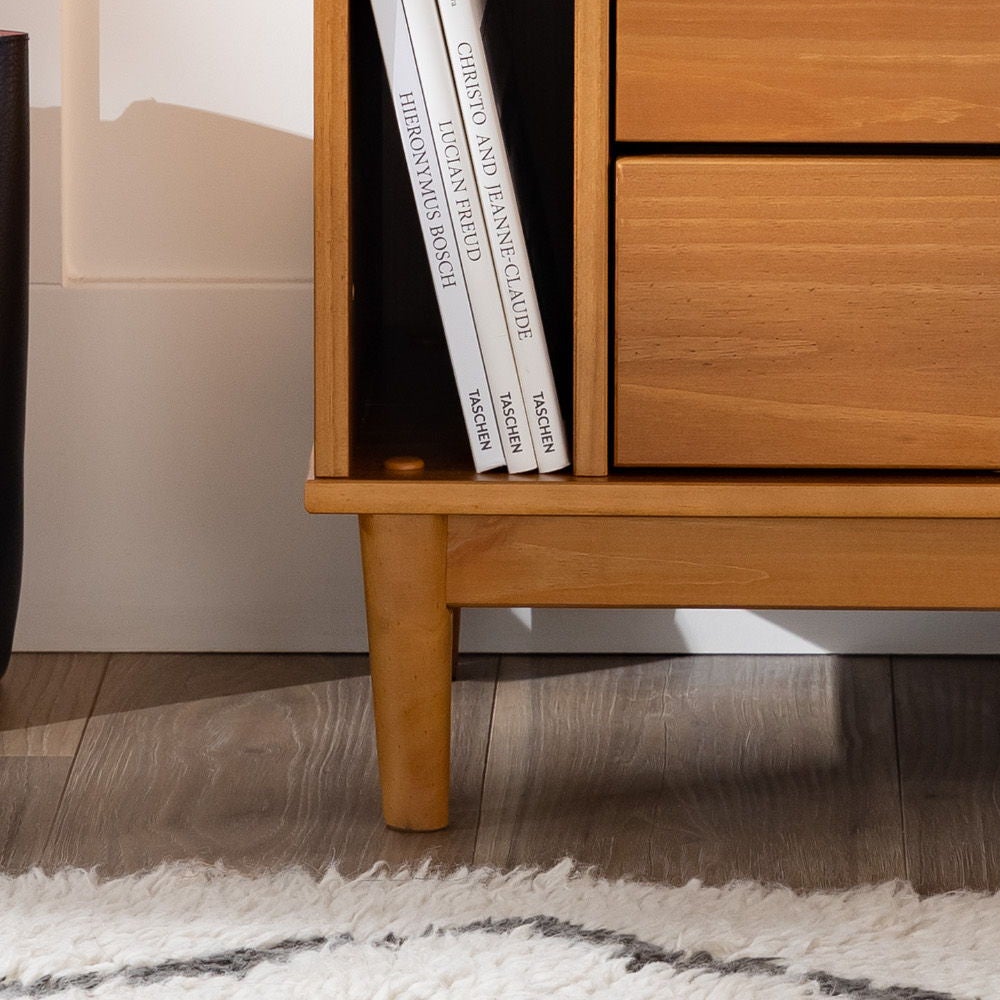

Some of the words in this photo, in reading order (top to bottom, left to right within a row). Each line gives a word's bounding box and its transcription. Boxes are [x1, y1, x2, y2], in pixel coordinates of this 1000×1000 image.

[457, 41, 487, 126] CHRISTO
[399, 91, 441, 221] HIERONYMUS
[429, 224, 456, 289] BOSCH
[438, 120, 467, 193] LUCIAN
[455, 198, 481, 262] FREUD
[476, 133, 497, 177] AND
[483, 184, 533, 341] JEANNE-CLAUDE
[468, 388, 492, 451] TASCHEN
[499, 391, 523, 454] TASCHEN
[532, 391, 555, 454] TASCHEN
